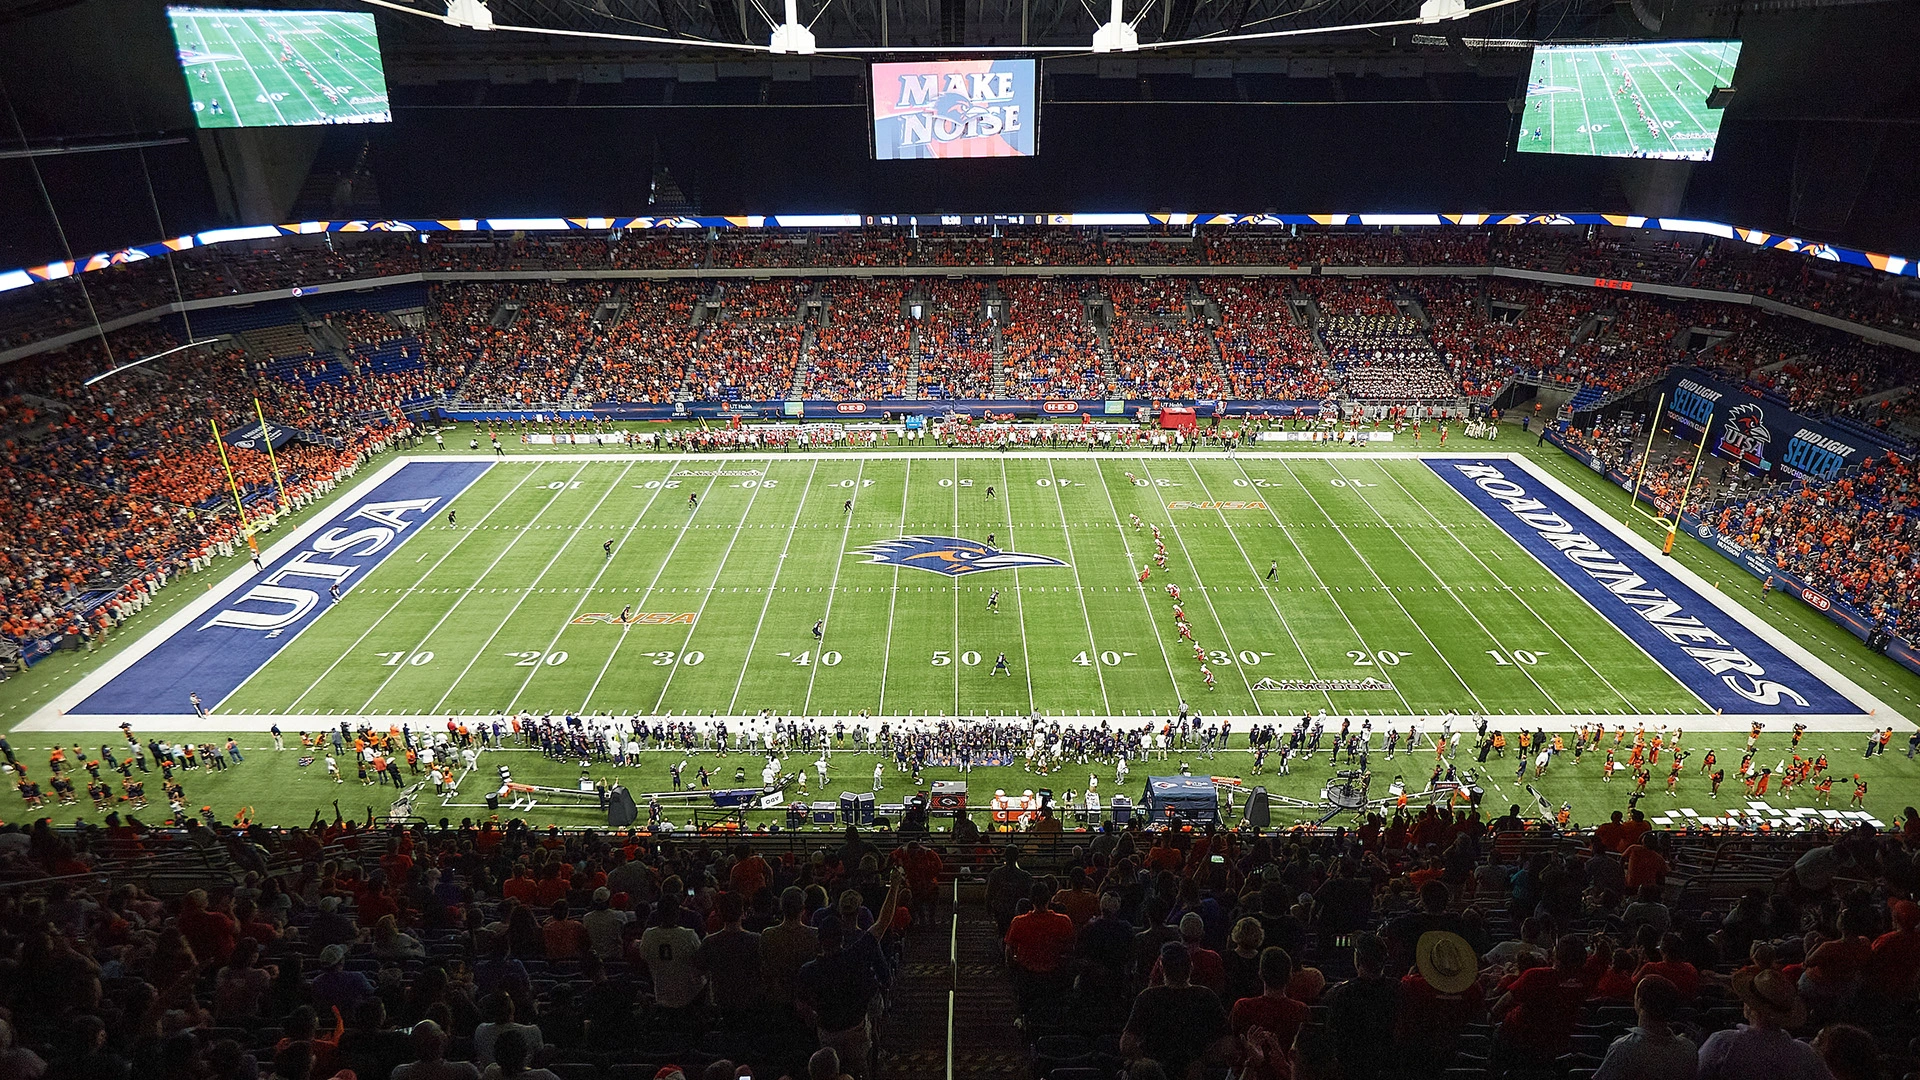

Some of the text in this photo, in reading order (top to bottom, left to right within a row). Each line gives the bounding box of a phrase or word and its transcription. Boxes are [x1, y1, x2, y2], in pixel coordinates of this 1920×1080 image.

[897, 72, 1015, 107] MAKE
[900, 104, 1022, 146] NOISE
[1678, 378, 1722, 401] BUD LIGHT
[1670, 387, 1714, 425] SELTZER
[1725, 428, 1762, 458] UTSA
[1794, 428, 1856, 457] BUD LIGHT
[1783, 437, 1844, 480] SELTZER
[196, 496, 442, 632] UTSA
[1454, 462, 1811, 708] ROADRUNNERS
[1804, 591, 1828, 609] H-E-B
[381, 651, 435, 666] 10
[514, 651, 570, 666] 20
[652, 651, 706, 666] 30
[791, 650, 843, 666] 40
[931, 650, 982, 666] 50
[1072, 650, 1122, 666] 40
[1209, 650, 1262, 666] 30
[1346, 650, 1401, 666] 20
[1485, 650, 1539, 666] 10
[1252, 681, 1393, 691] ALAMODOME
